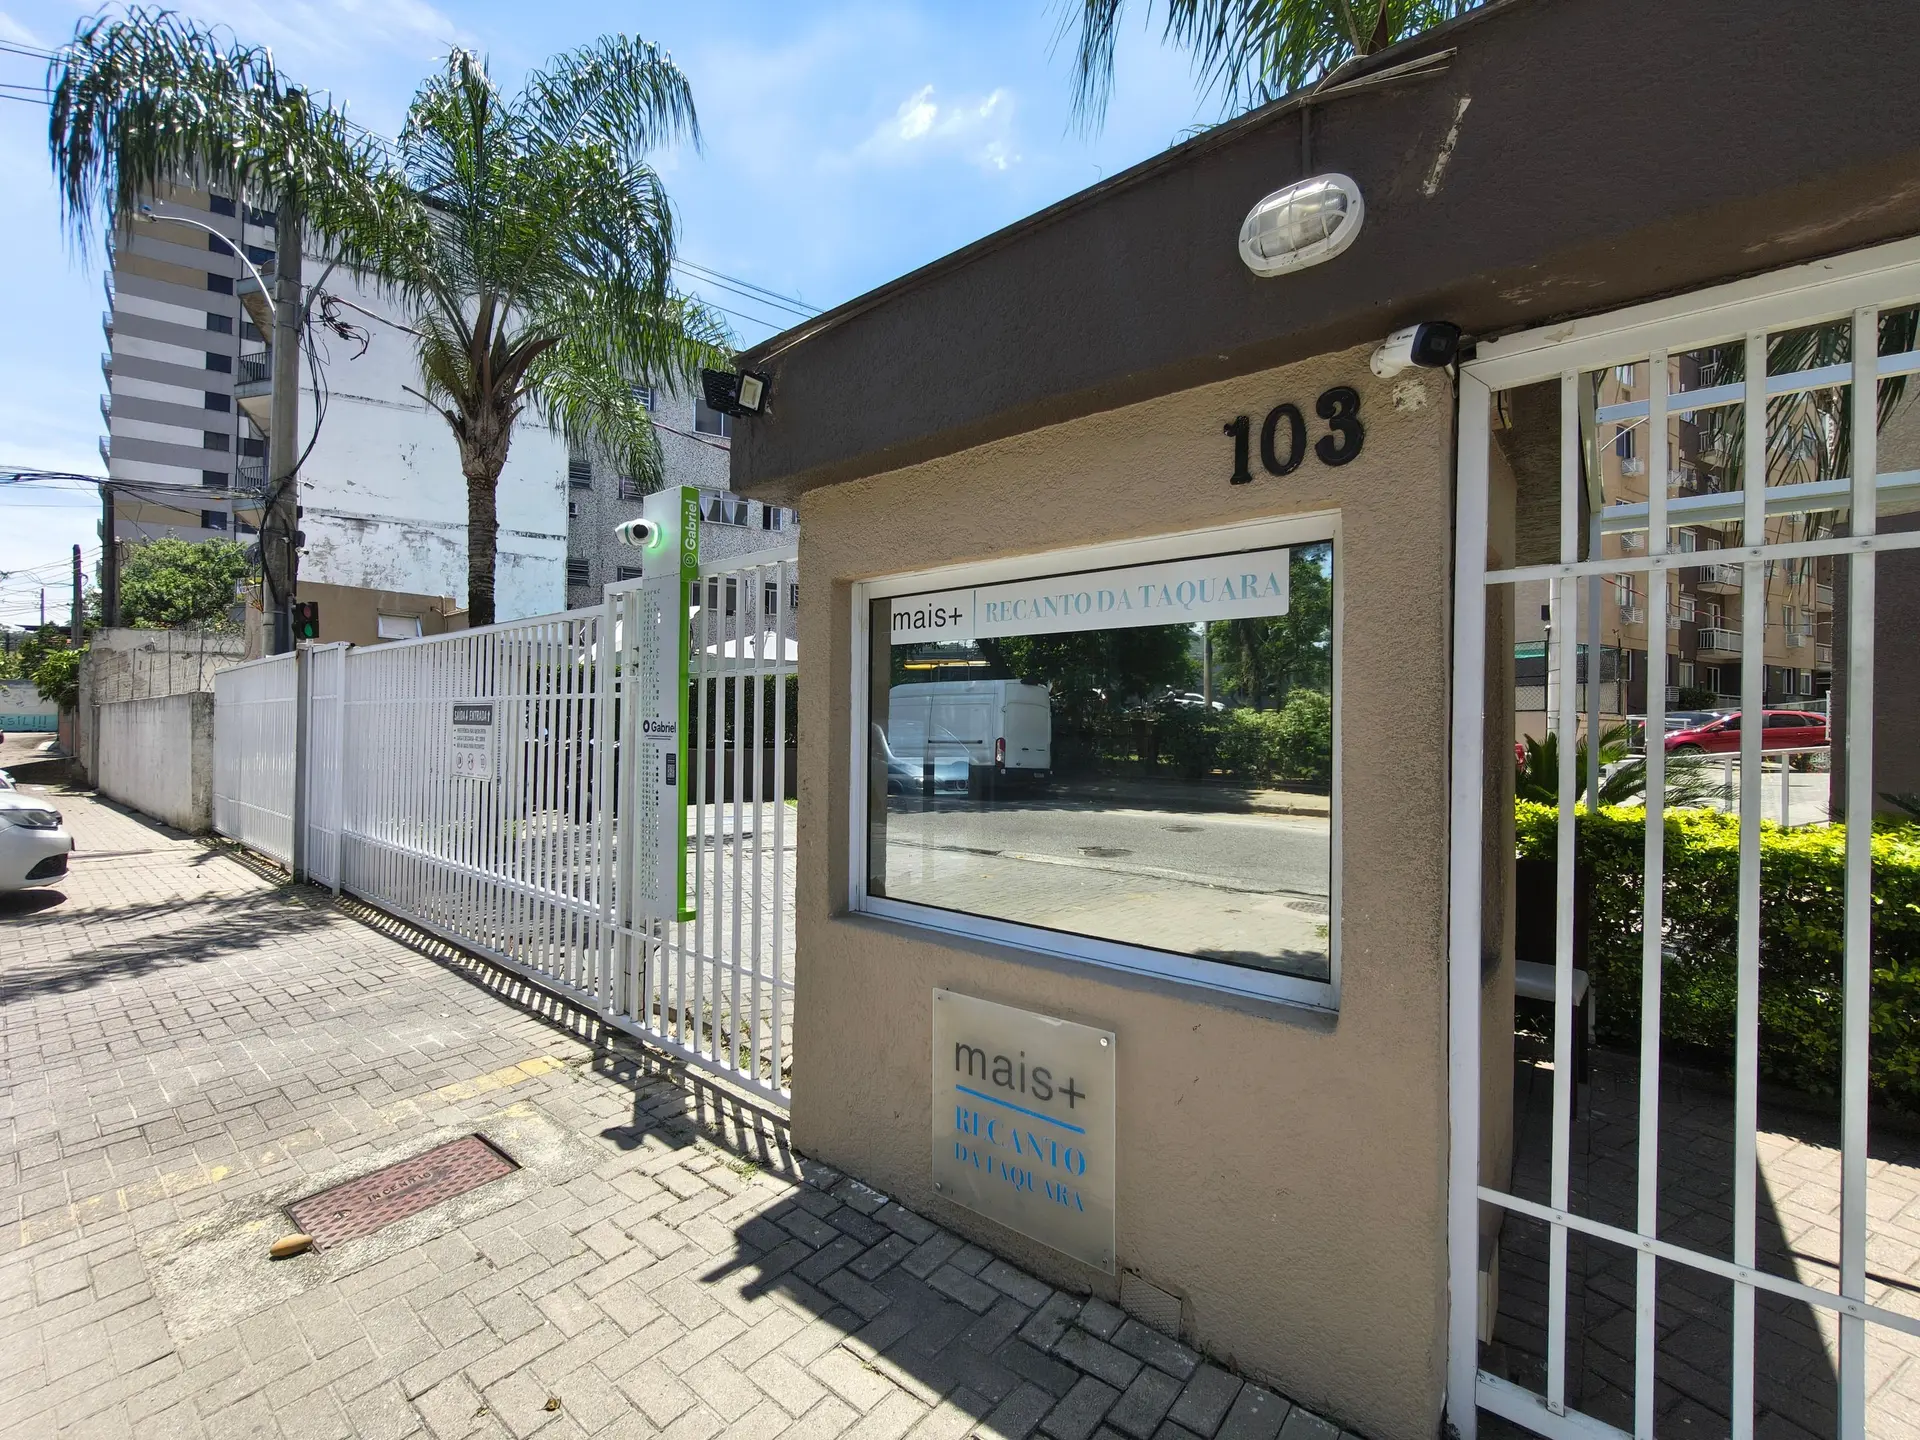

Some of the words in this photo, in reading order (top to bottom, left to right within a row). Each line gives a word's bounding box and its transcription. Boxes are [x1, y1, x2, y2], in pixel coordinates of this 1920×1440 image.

[1223, 386, 1365, 485] 103
[684, 500, 698, 550] Gabriel
[893, 603, 963, 631] mais+
[985, 592, 1092, 623] RECANTO
[1097, 588, 1134, 613] DA
[1138, 572, 1284, 610] TAQUARA
[651, 721, 677, 733] Gabriel
[955, 1042, 1086, 1109] mais+
[956, 1105, 1086, 1177] RECANTO
